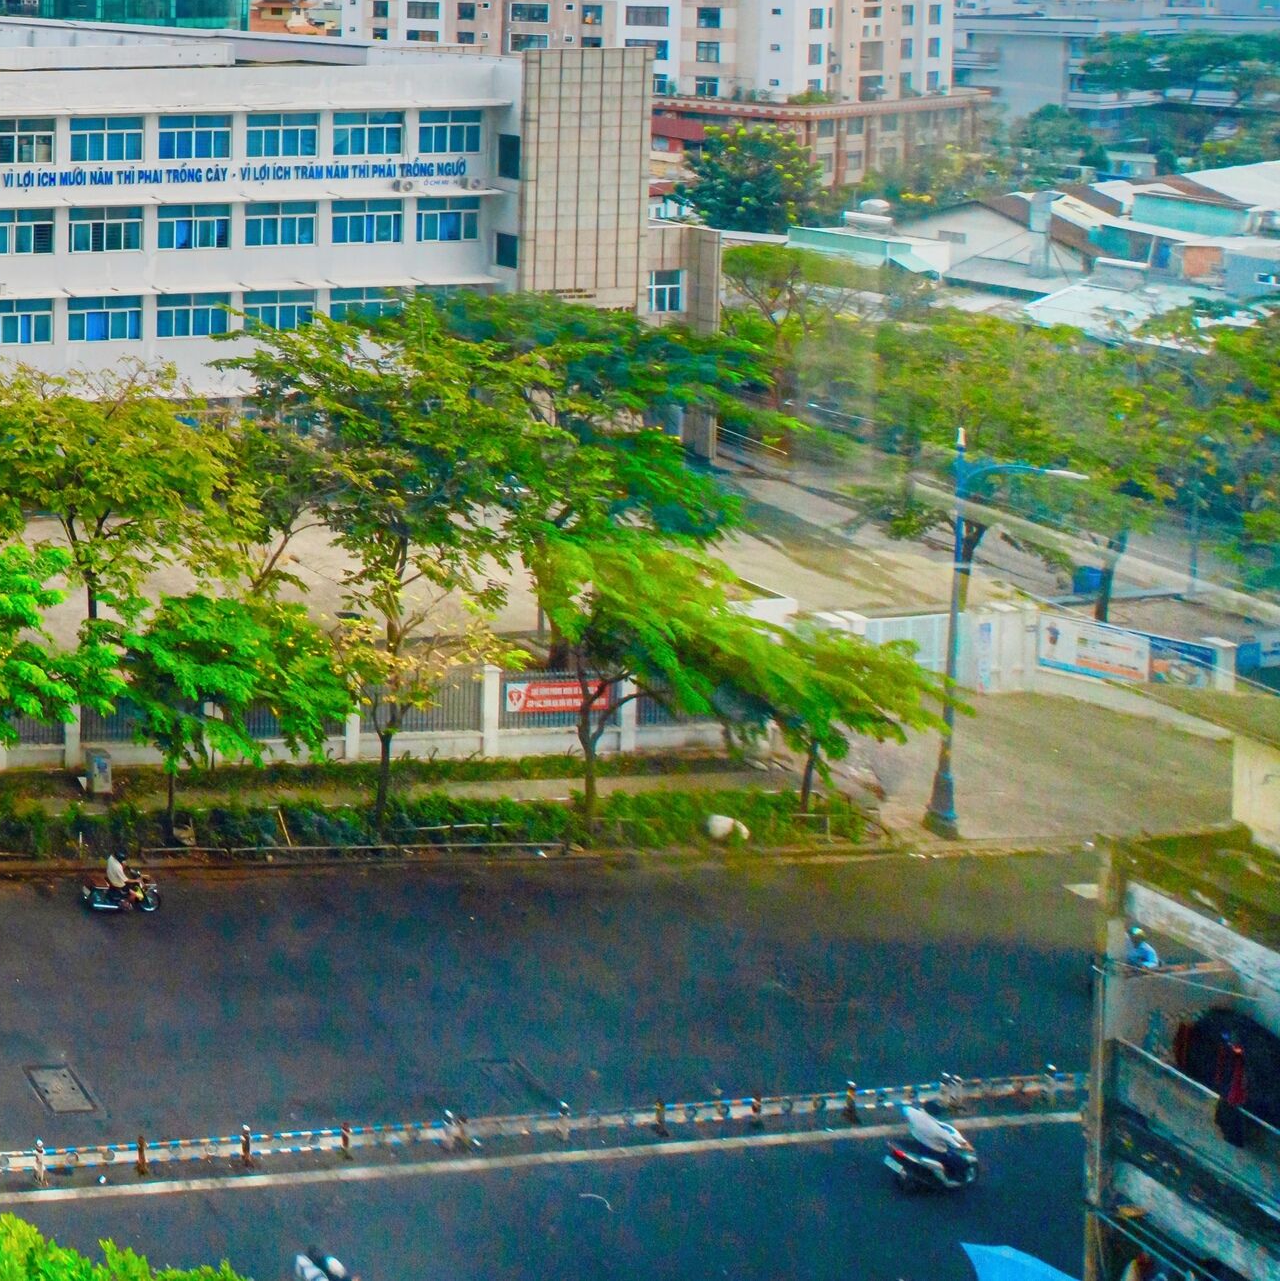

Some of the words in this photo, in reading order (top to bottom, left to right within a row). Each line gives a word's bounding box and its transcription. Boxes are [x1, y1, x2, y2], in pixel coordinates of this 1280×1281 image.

[17, 169, 34, 192] LỢI
[37, 168, 57, 187] ÍCH
[90, 167, 113, 185] NĂM
[205, 164, 228, 182] CÂY
[253, 164, 270, 185] LỢI
[272, 162, 291, 180] ÍCH
[294, 161, 323, 180] TRĂM
[325, 160, 349, 179] NĂM
